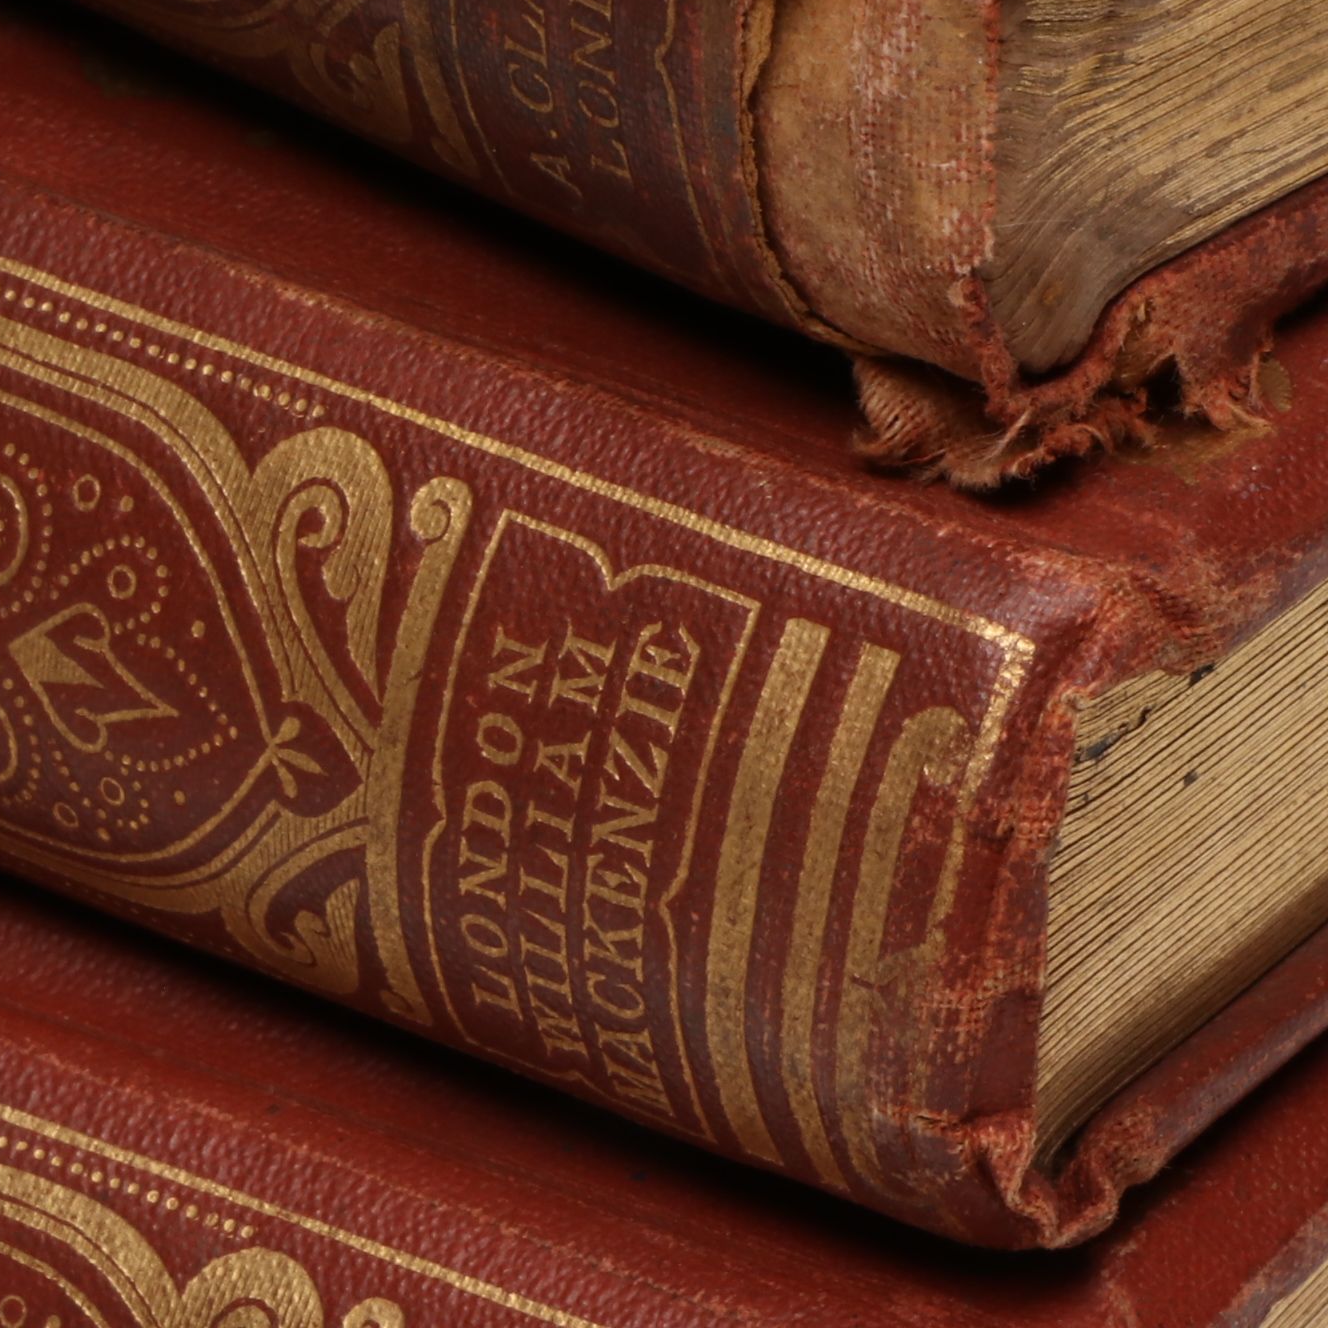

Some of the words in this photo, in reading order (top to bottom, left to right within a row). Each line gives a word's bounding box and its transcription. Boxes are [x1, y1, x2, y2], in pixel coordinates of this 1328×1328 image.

[458, 624, 550, 1022] LONDON
[517, 617, 617, 1061] WILLIAM
[581, 619, 702, 1118] MACKENZIE
